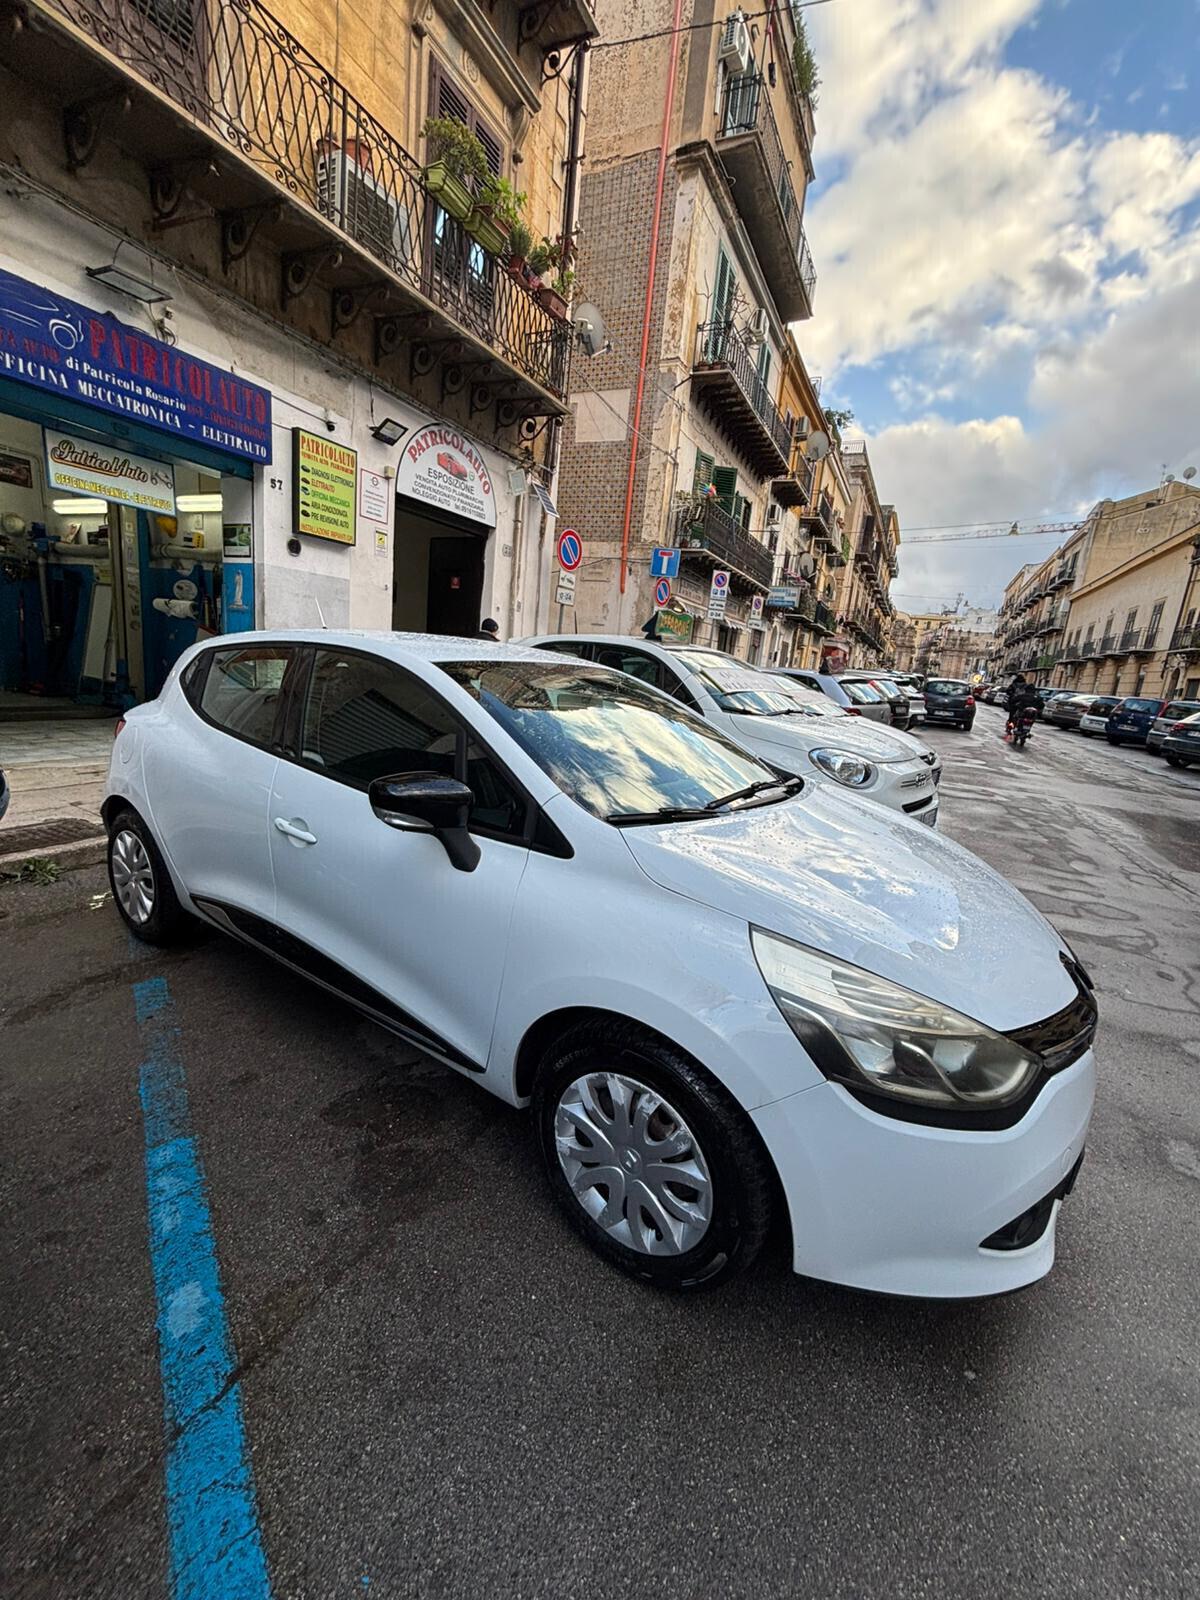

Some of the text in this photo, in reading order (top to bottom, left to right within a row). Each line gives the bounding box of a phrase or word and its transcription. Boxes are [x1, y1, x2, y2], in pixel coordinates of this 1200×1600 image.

[66, 356, 186, 411] di Patricola Rosario
[89, 319, 267, 425] PATRICOLAUTO
[78, 379, 181, 429] MECCATRONICA
[202, 425, 267, 458] ELETTRAUTO
[301, 435, 355, 469] PATRICOLAUTO
[406, 428, 491, 495] PATRICOLAUTO
[270, 478, 283, 491] 57
[414, 480, 456, 502] CONVENZIONATO
[415, 473, 437, 486] VENDITA
[438, 484, 451, 493] AUTO
[428, 467, 475, 495] ESPOSIZIONE
[412, 487, 437, 502] NOLEGGIO
[438, 497, 450, 507] AUTO
